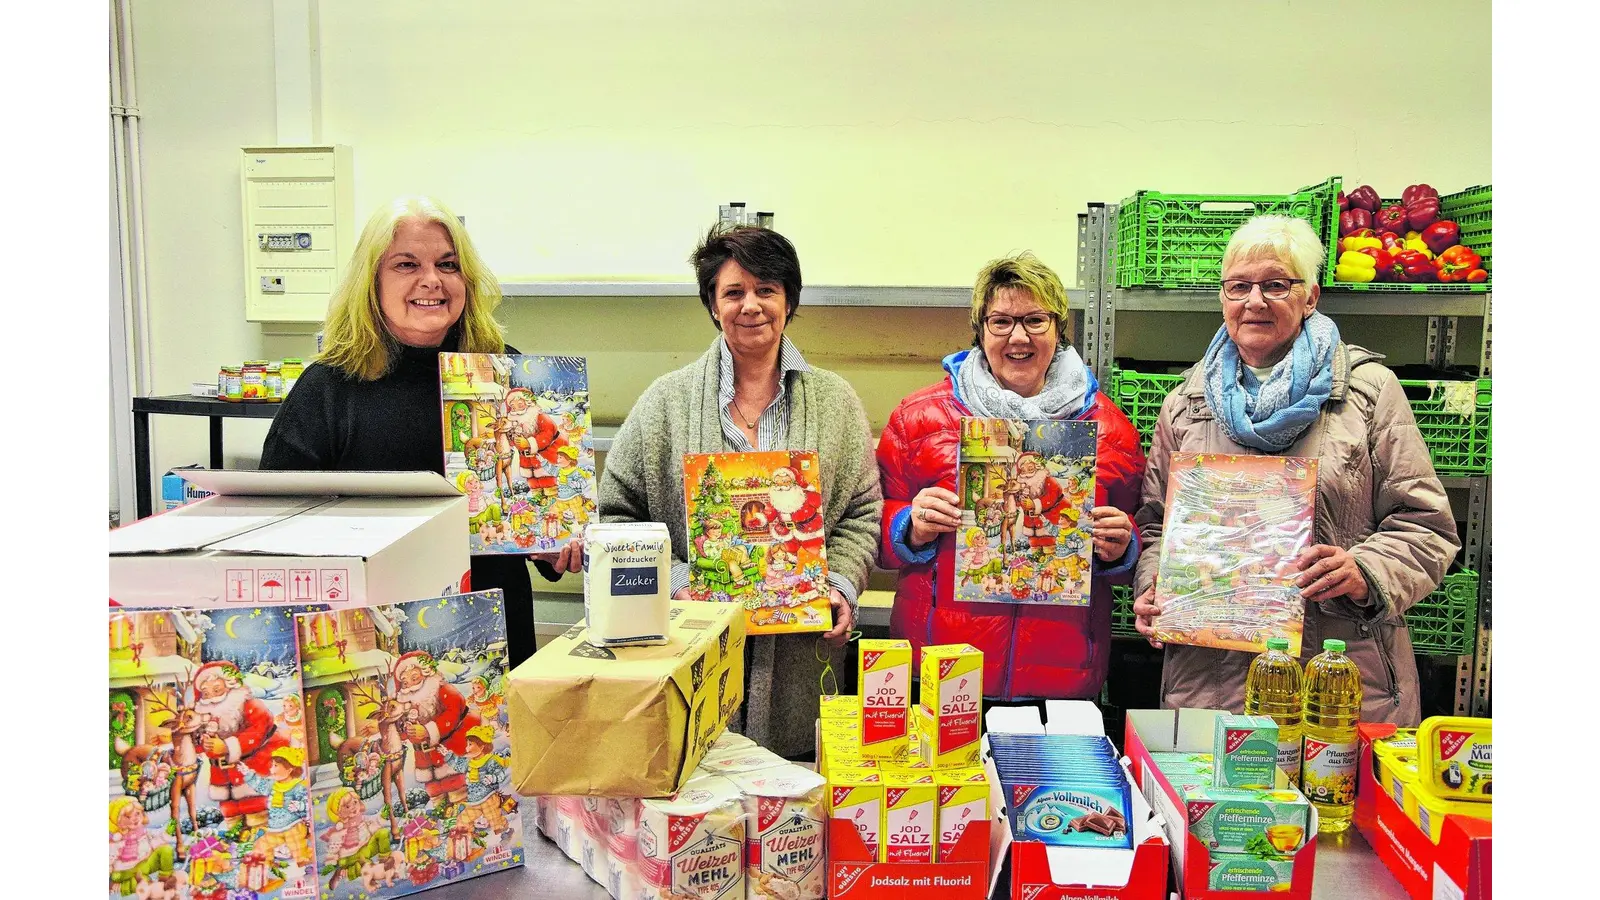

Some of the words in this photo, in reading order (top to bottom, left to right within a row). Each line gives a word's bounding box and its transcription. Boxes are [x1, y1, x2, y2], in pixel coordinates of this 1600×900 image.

[604, 542, 631, 553] Sweet
[633, 540, 665, 554] Family
[612, 555, 657, 564] Nordzucker
[615, 574, 656, 587] Zucker
[876, 688, 897, 696] JOD
[866, 696, 905, 707] SALZ
[951, 694, 970, 703] JOD
[942, 702, 978, 715] SALZ
[1441, 733, 1453, 744] GUT
[1444, 735, 1466, 756] GÜNSTIG
[1230, 755, 1274, 763] Pfefferminze
[1225, 807, 1260, 815] erfrischende
[1219, 813, 1273, 824] Pfefferminze
[671, 817, 684, 832] GUT
[779, 823, 813, 835] QUALITÄTS
[900, 825, 922, 833] JOD
[952, 823, 966, 831] JO
[673, 817, 700, 846] GÜNSTIG
[942, 831, 961, 842] SA
[890, 834, 930, 844] SALZ
[691, 842, 727, 856] QUALITÄTS
[889, 848, 902, 857] mit
[903, 848, 930, 858] Fluorid
[485, 852, 511, 863] WINDEL
[677, 851, 738, 874] Weizen
[777, 847, 814, 867] MEHL
[786, 865, 798, 875] TYPE
[798, 863, 807, 873] 405
[836, 866, 848, 878] GUT
[688, 867, 730, 887] MEHL
[838, 867, 862, 890] GÜNSTIG
[871, 875, 909, 888] Jodsalz
[912, 875, 930, 886] mit
[933, 875, 972, 886] Fluorid
[1221, 873, 1275, 883] Pfefferminze
[284, 888, 314, 896] WINDEL
[697, 885, 710, 895] TYPE
[710, 882, 720, 892] 405
